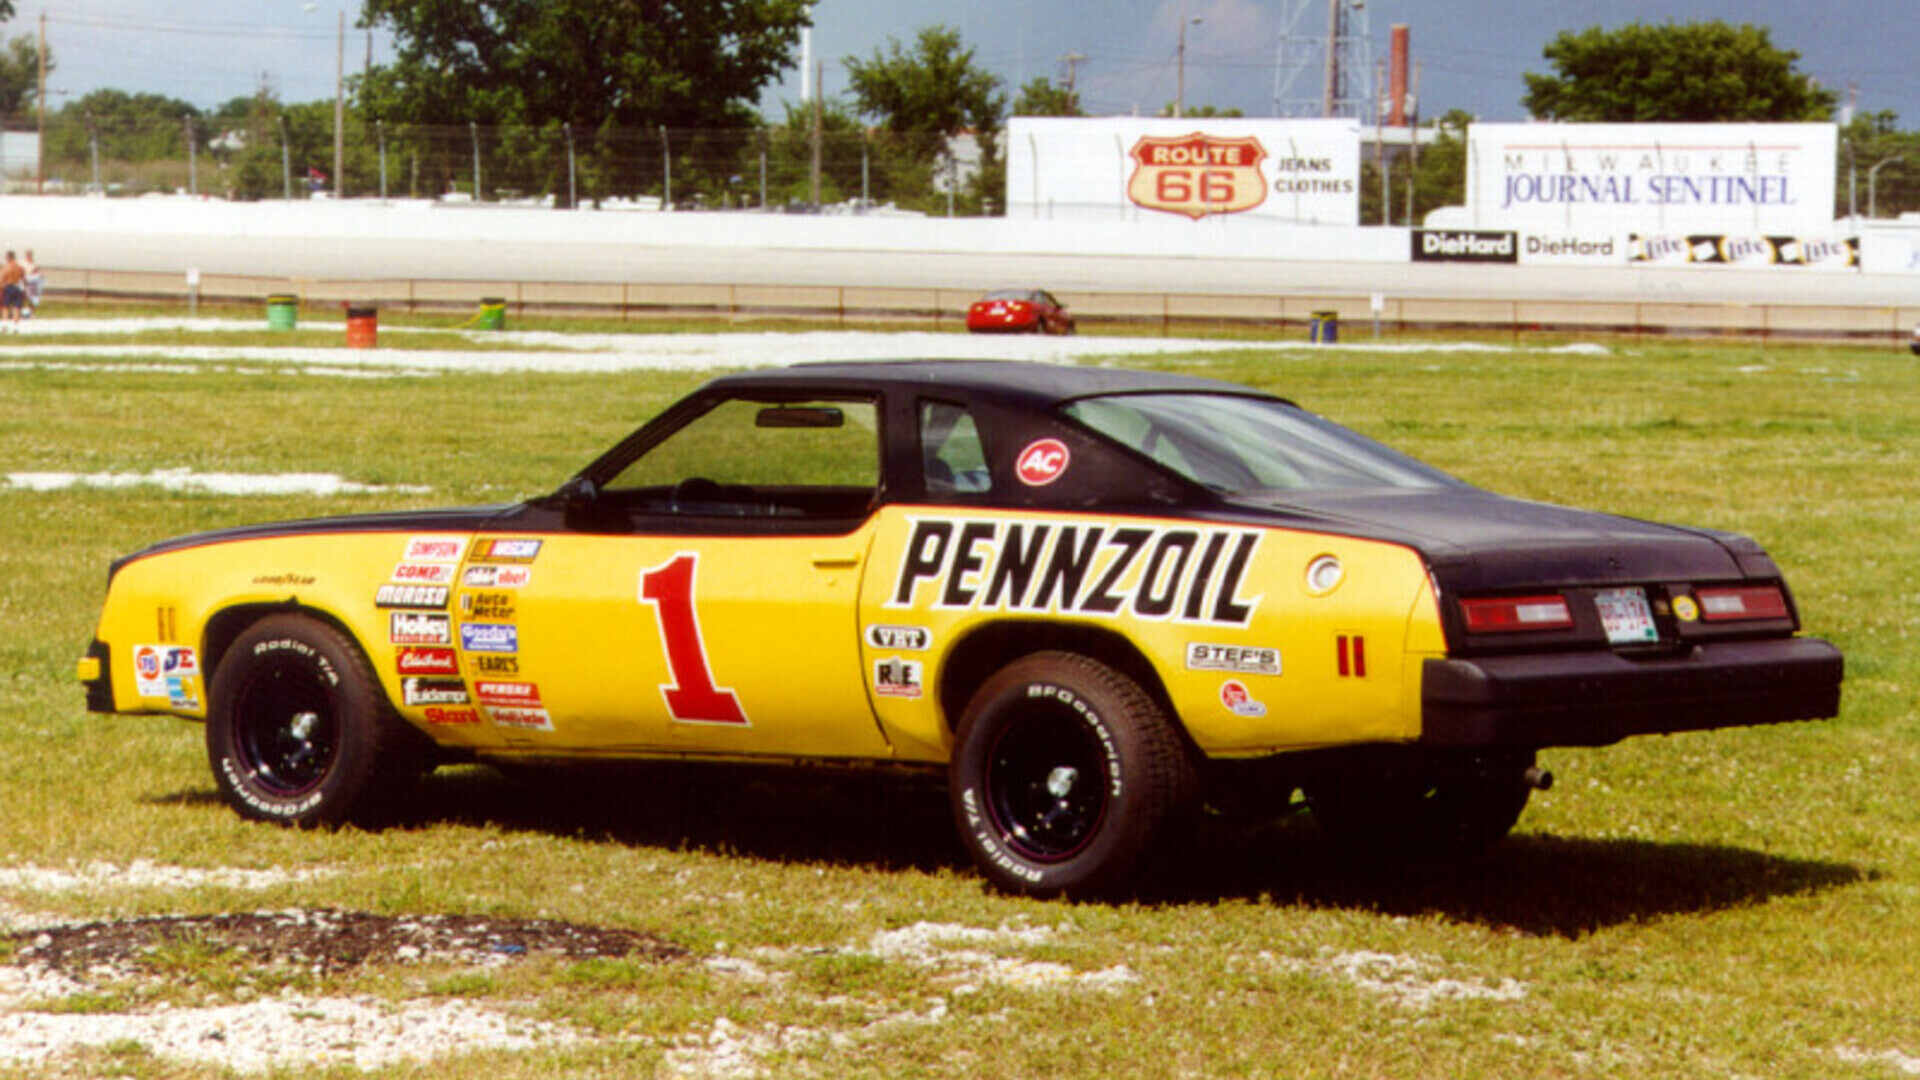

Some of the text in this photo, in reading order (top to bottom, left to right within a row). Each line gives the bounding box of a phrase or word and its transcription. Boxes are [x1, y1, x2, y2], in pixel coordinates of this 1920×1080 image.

[1152, 146, 1242, 164] ROUTE
[1279, 157, 1332, 172] JEANS
[1156, 169, 1236, 203] 66
[1274, 178, 1354, 194] CLOTHES
[1502, 174, 1797, 209] JOURNAL SENTINEL
[1423, 232, 1513, 255] DieHard
[1526, 235, 1614, 256] DieHard
[1022, 449, 1062, 472] AC
[891, 518, 1263, 626] PENNZOIL
[640, 552, 750, 726] 1
[879, 627, 921, 649] VHT
[1193, 644, 1276, 665] STEF'S
